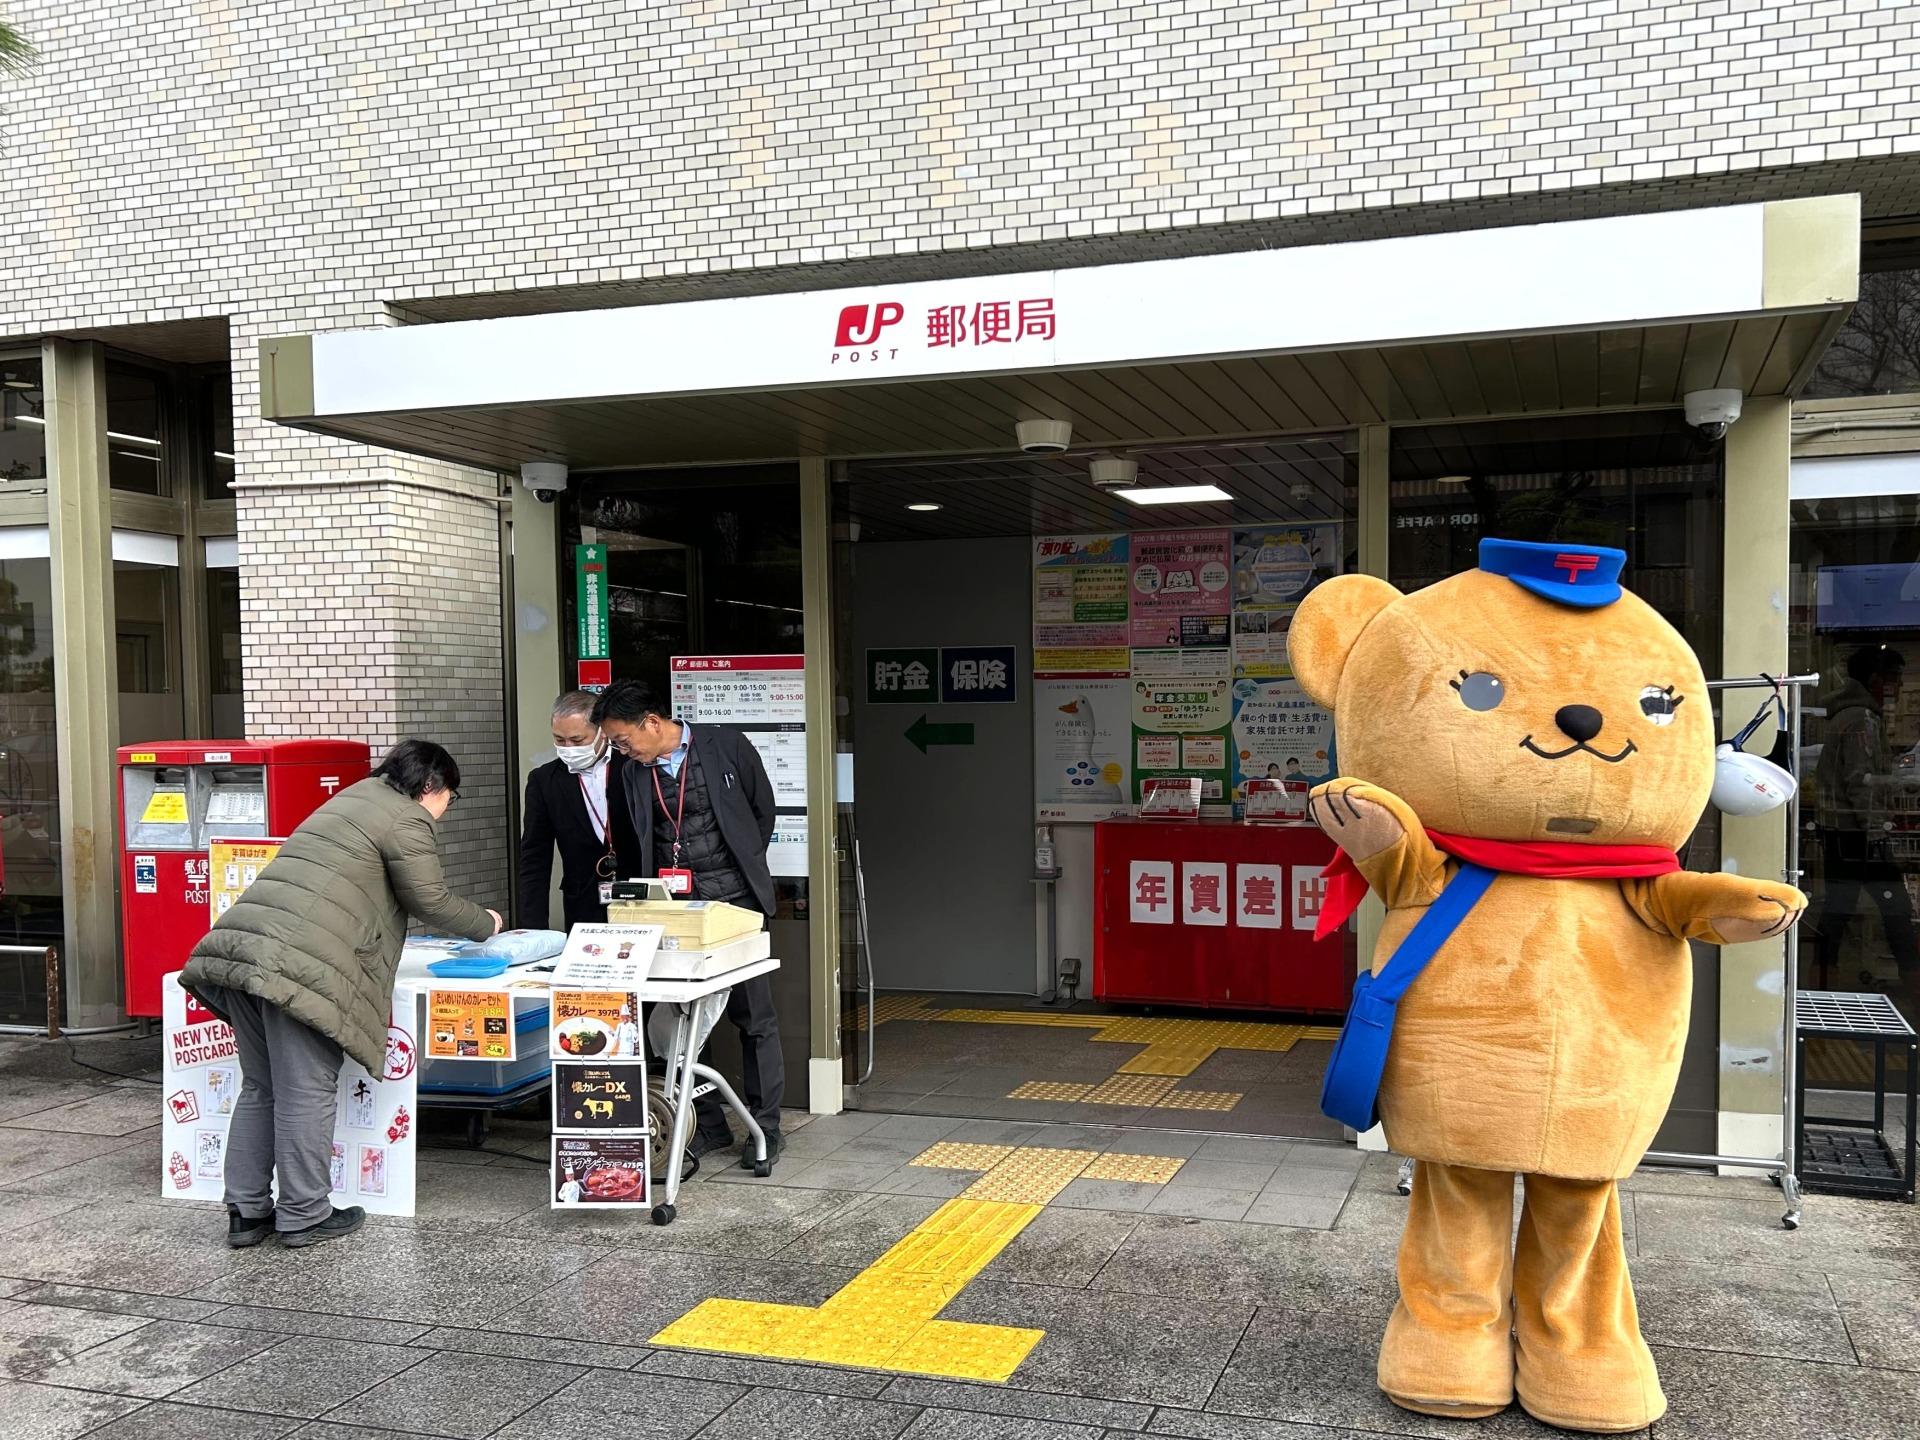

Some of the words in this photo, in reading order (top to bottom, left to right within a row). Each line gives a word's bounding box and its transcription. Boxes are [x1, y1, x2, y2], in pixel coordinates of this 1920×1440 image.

[926, 297, 1056, 348] 郵便局
[831, 348, 899, 364] POST
[874, 660, 930, 691] 貯金
[950, 659, 1007, 690] 保険
[697, 684, 731, 692] 9:00-19:00
[1156, 693, 1206, 703] 年金受取り
[1055, 720, 1088, 728] がん保険に
[1240, 713, 1328, 723] 親の介護費・生活費は
[1246, 725, 1321, 735] 家族信託で対策！
[232, 848, 267, 858] 年賀はがき
[184, 859, 209, 876] 郵便
[185, 890, 210, 904] POST
[557, 1004, 596, 1017] 懐カレー
[597, 1009, 620, 1017] 397円
[173, 1028, 201, 1049] NEW
